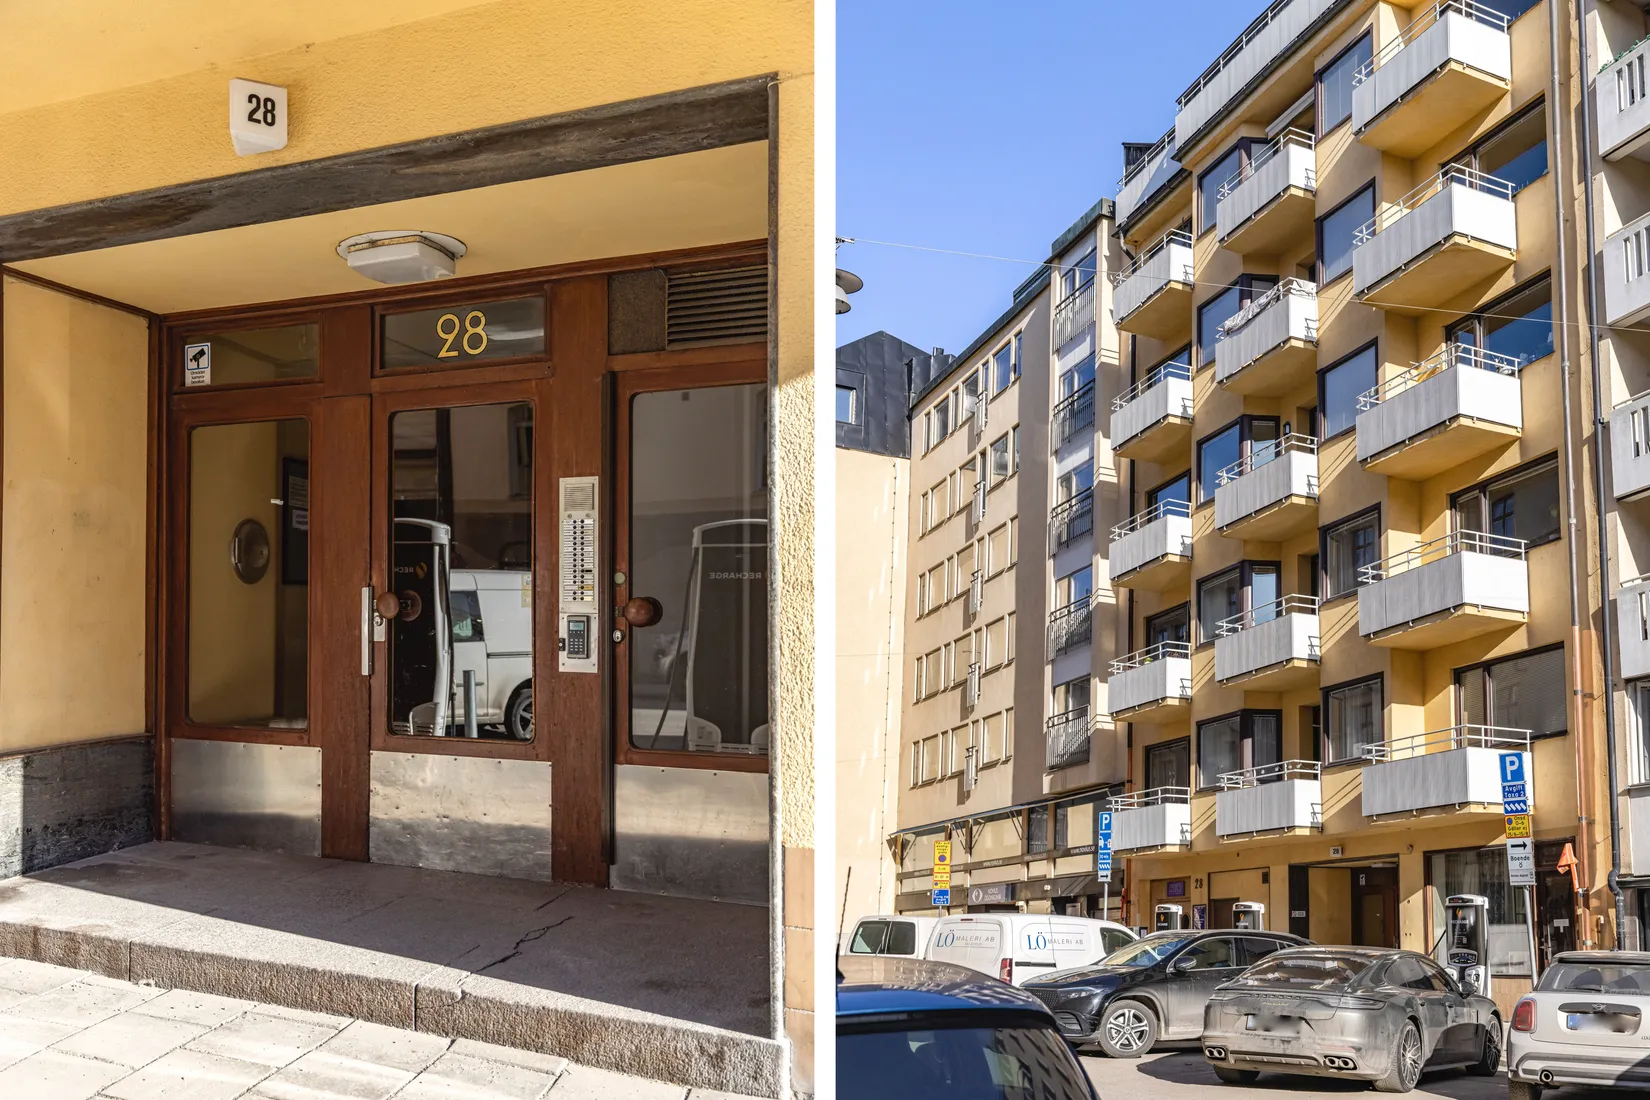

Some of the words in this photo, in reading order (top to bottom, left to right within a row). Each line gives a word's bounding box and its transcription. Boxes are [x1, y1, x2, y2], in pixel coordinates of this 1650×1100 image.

[247, 93, 276, 127] 28
[436, 310, 489, 359] 28
[1505, 755, 1520, 781] P
[1504, 784, 1523, 792] Avgift
[1102, 813, 1110, 830] P
[936, 929, 955, 948] LÖ
[1027, 931, 1047, 950] LÖ
